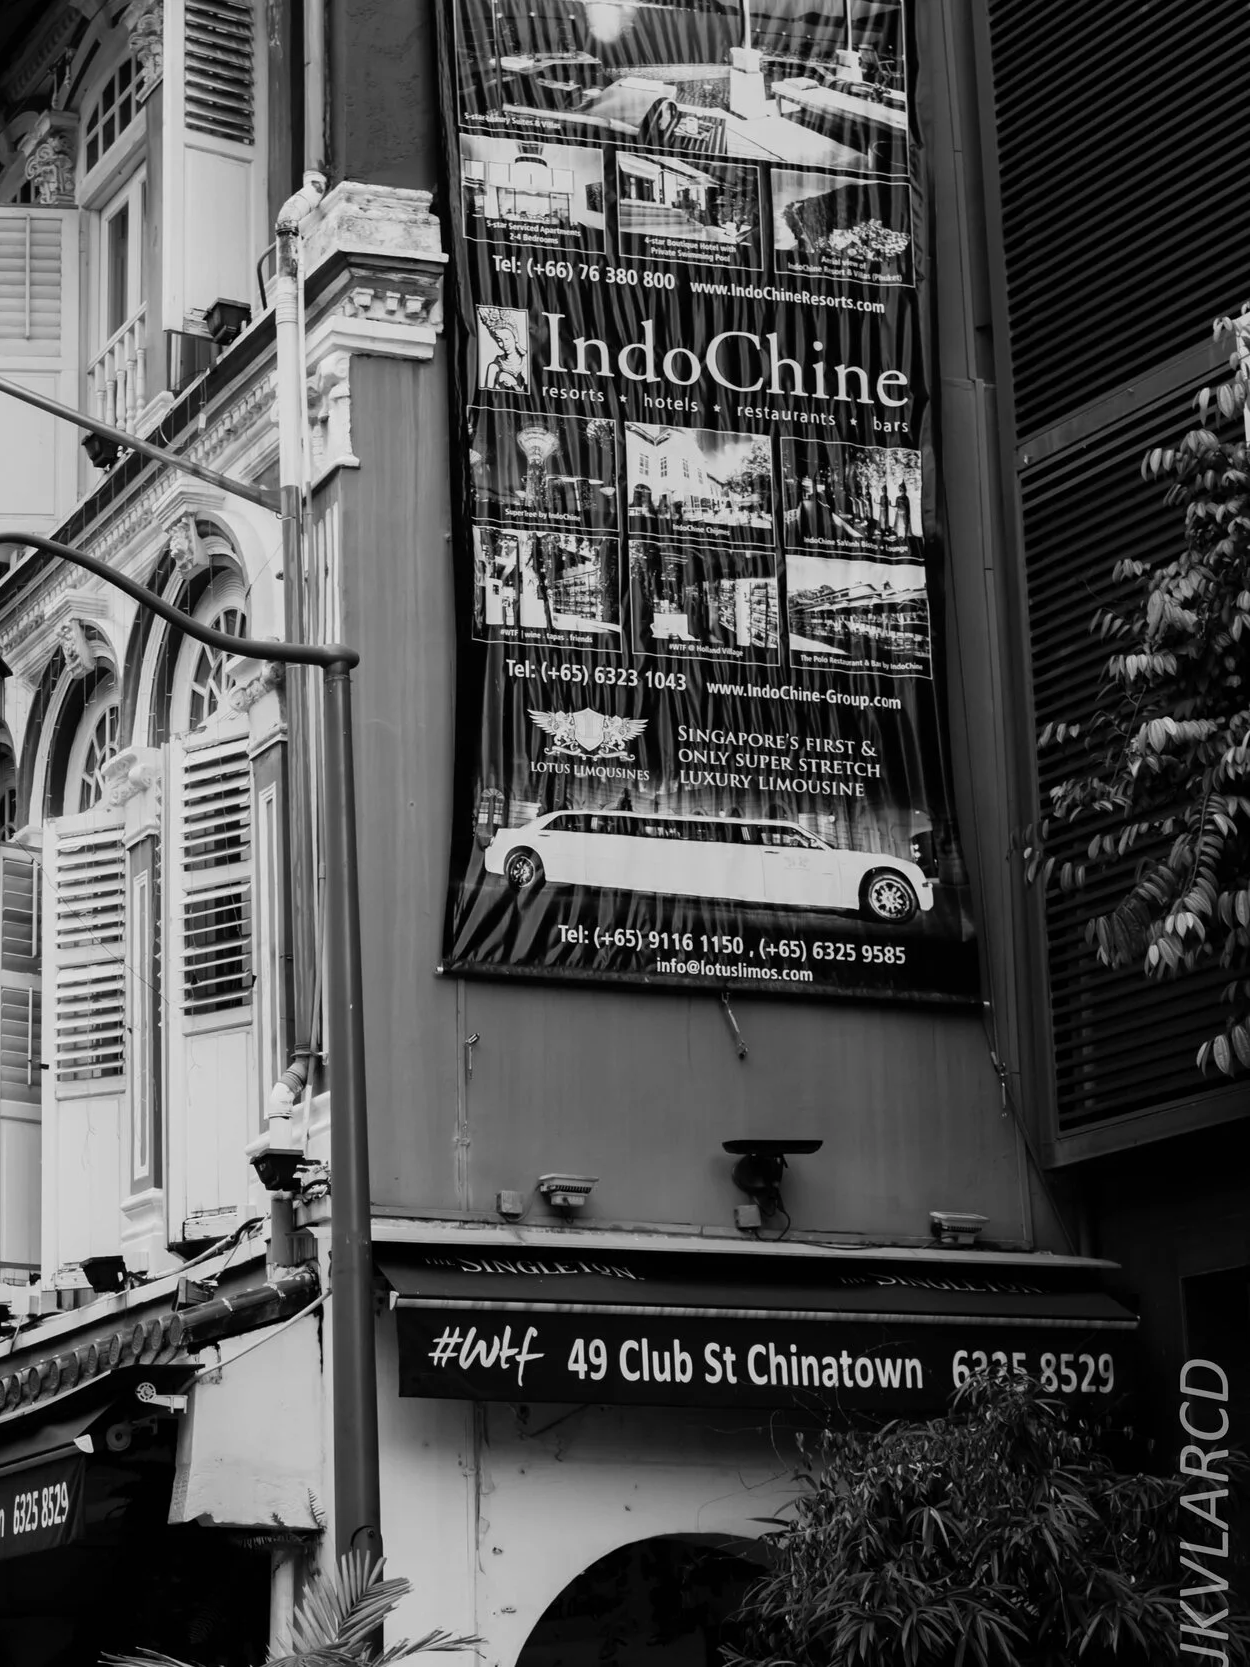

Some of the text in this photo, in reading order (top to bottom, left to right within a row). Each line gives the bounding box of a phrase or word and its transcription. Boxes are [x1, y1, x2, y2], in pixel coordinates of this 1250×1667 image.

[486, 220, 581, 237] 5-star Serviced Apartments
[509, 233, 559, 245] 2-4 Bedrooms
[645, 237, 737, 253] 4-star Boutique Hotel with
[651, 246, 731, 263] Private Swimming Pool
[492, 255, 675, 289] Tel: (+66) 76 380 800
[788, 262, 902, 283] IndoChine Resort & Villas (Phuket)
[821, 255, 867, 269] Aerial view of
[690, 281, 885, 313] www.IndoChineResorts.com
[541, 311, 908, 407] IndoChine
[542, 385, 909, 433] resorts hotels restaurants bars
[505, 508, 581, 522] SuperTree by IndoChine
[672, 523, 705, 534] IndoChine
[803, 536, 835, 546] IndoChine
[885, 545, 909, 553] Lounge
[500, 629, 519, 637] #WTF
[524, 630, 541, 639] wine
[547, 632, 565, 643] tapas
[569, 632, 593, 643] friends
[669, 643, 744, 658] #WTF @ Holland Village
[801, 655, 923, 671] The Polo Restaurant & Bar by IndoChine
[506, 659, 687, 691] Tel: (+65) 6323 1043
[706, 682, 901, 710] www.IndoChine-Group.com
[677, 725, 877, 756] SINGAPORE'S FIRST &
[530, 761, 650, 781] LOTUS LIMOUSINES
[678, 748, 881, 778] ONLY SUPER STRETCH
[680, 770, 865, 797] LUXURY LIMOUSINE
[558, 924, 589, 944] Tel:
[593, 926, 643, 951] (+65)
[649, 931, 693, 951] 9116
[700, 935, 743, 954] 1150
[758, 938, 807, 962] (+65)
[812, 942, 856, 961] 6325
[862, 944, 906, 964] 9585
[656, 957, 813, 982] info@lotuslimos.com
[567, 1338, 607, 1381] 49
[619, 1337, 693, 1384] Club
[704, 1342, 737, 1385] St
[748, 1342, 924, 1389] Chinatown
[1040, 1352, 1115, 1394] 8529
[12, 1491, 39, 1536] 6325
[41, 1481, 69, 1528] 8529
